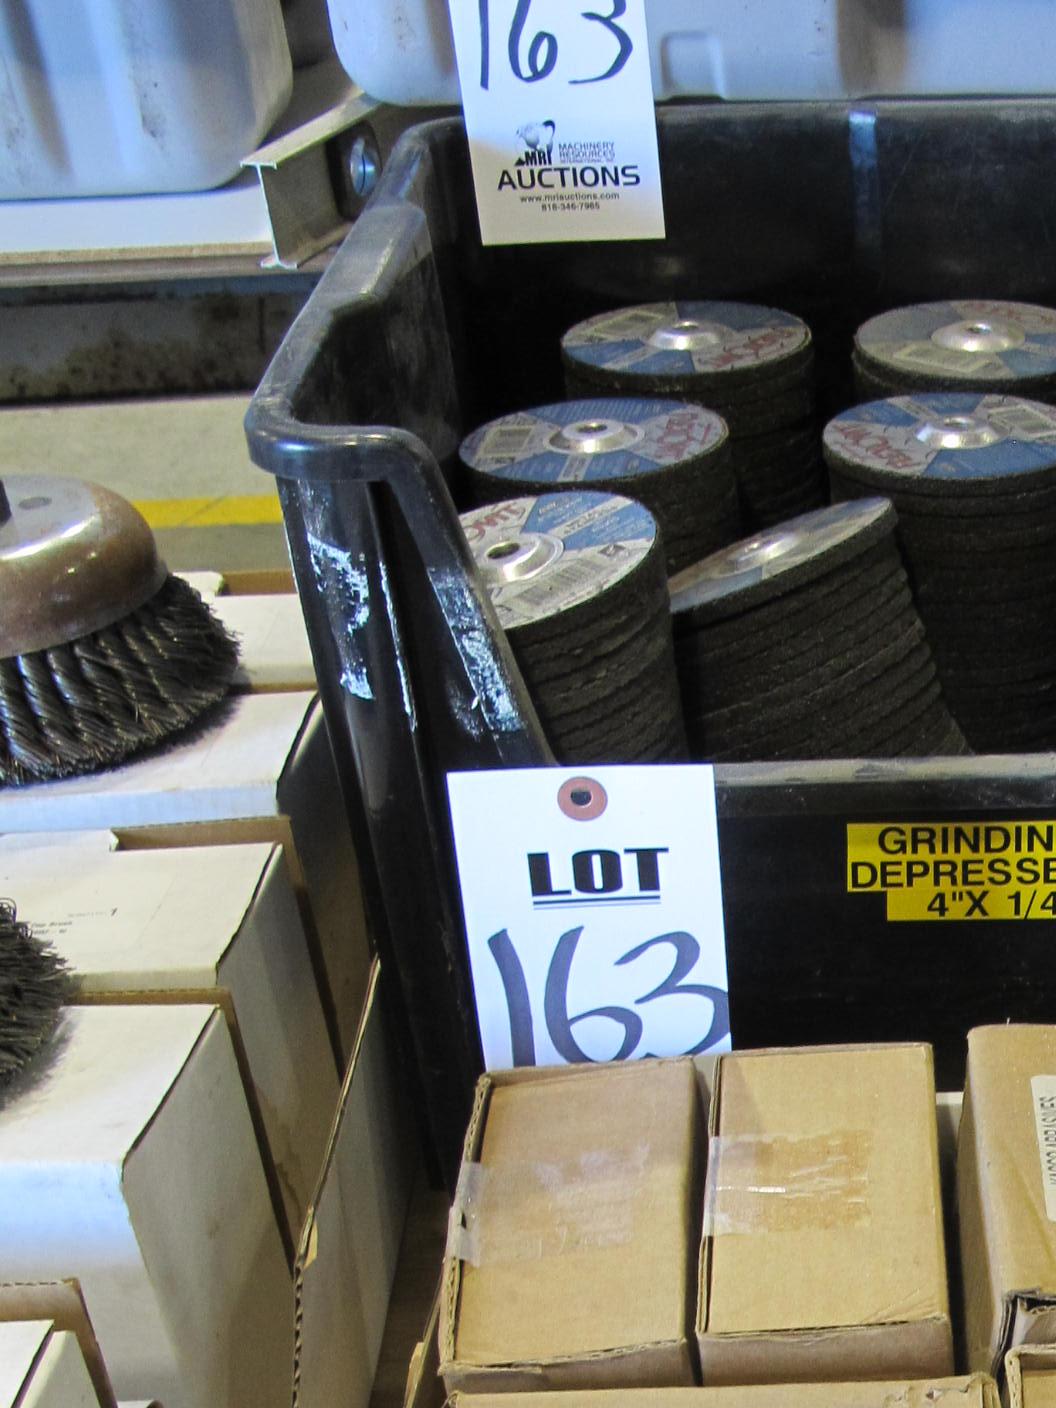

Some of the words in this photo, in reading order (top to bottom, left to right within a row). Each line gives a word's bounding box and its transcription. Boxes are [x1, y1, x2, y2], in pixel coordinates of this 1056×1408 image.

[497, 165, 641, 191] AUCTIONS
[526, 847, 669, 896] LOT
[487, 925, 732, 1066] 163
